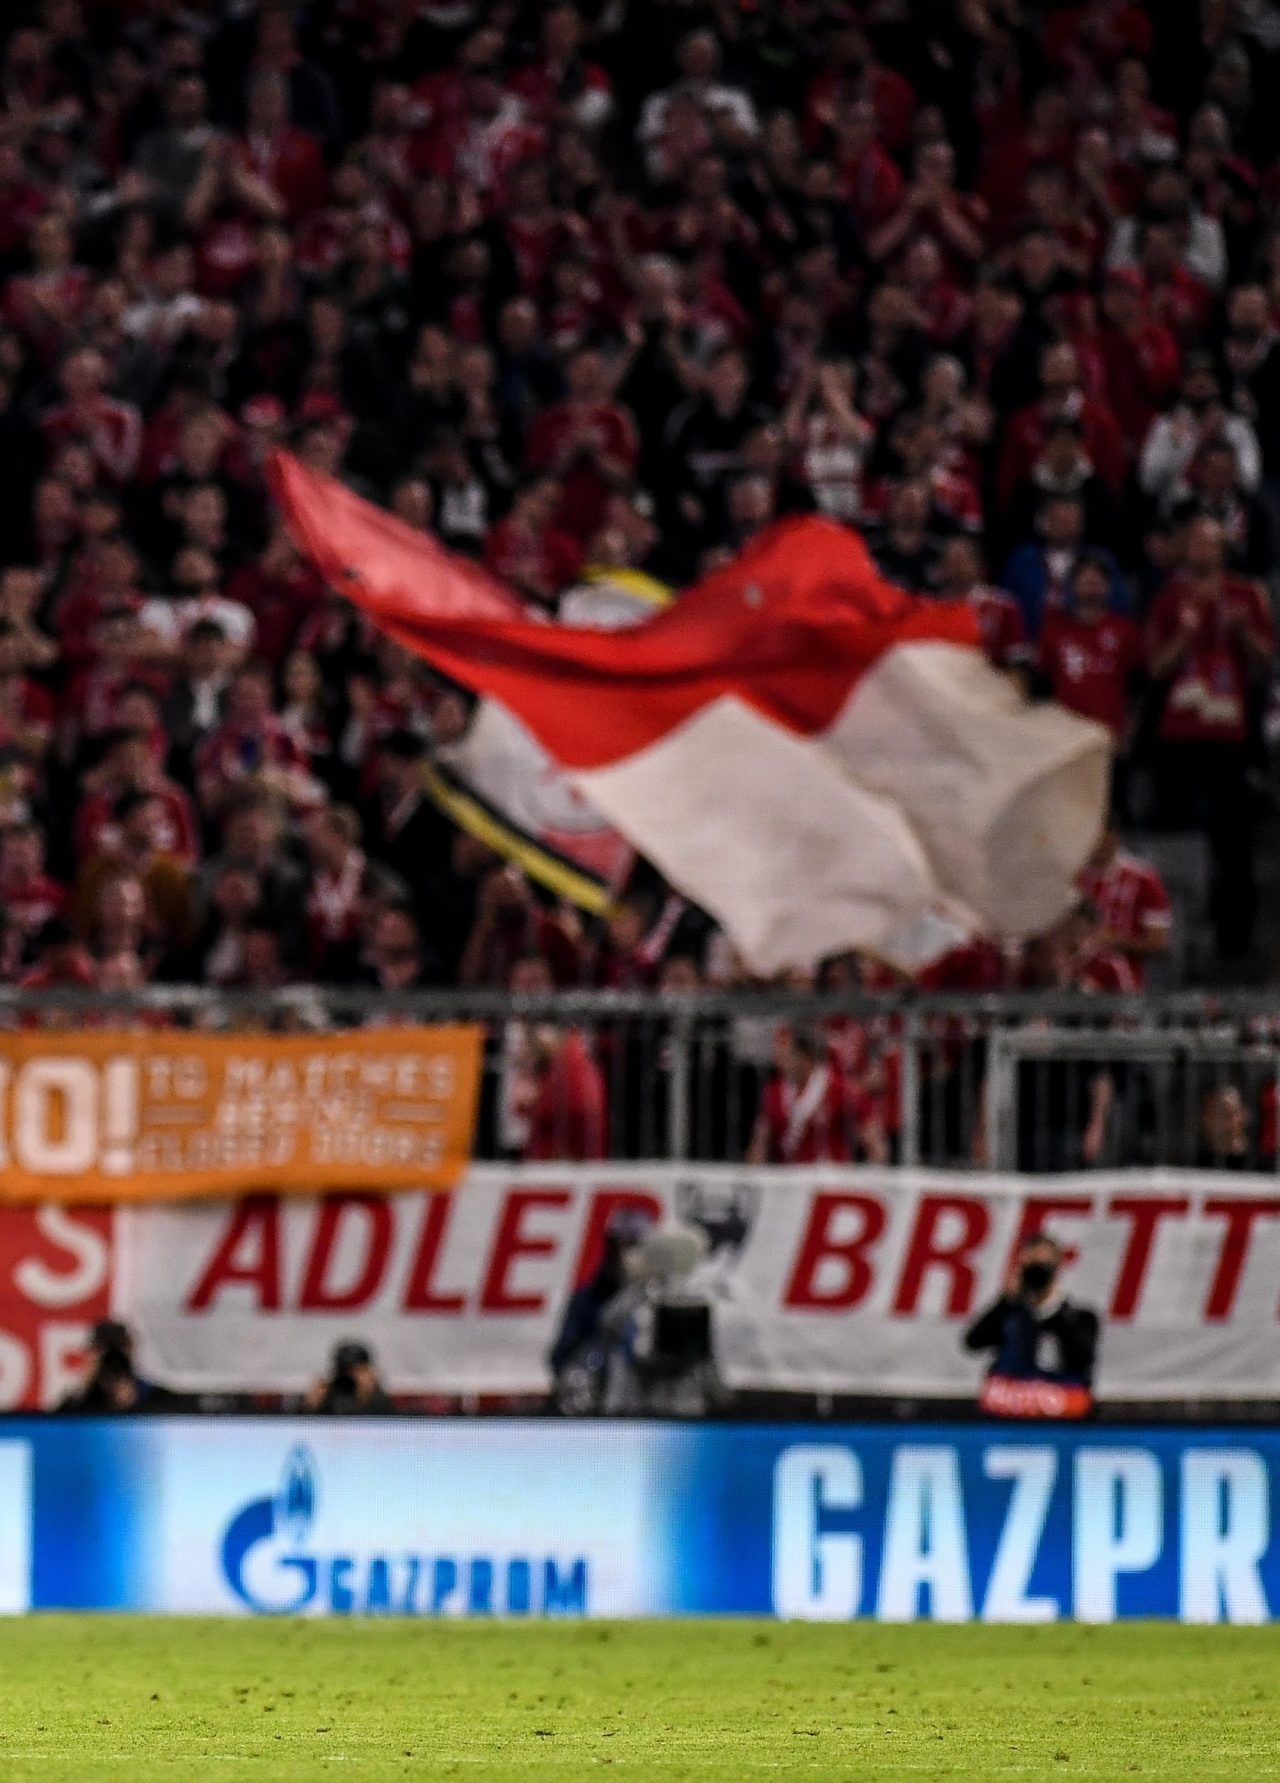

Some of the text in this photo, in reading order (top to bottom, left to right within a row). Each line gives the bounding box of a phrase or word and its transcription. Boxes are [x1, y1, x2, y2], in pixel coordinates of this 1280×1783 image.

[144, 1056, 209, 1099] TO
[782, 1190, 1280, 1325] BRETT
[772, 1443, 1272, 1624] GAZPR
[330, 1555, 588, 1617] GAZPROM
